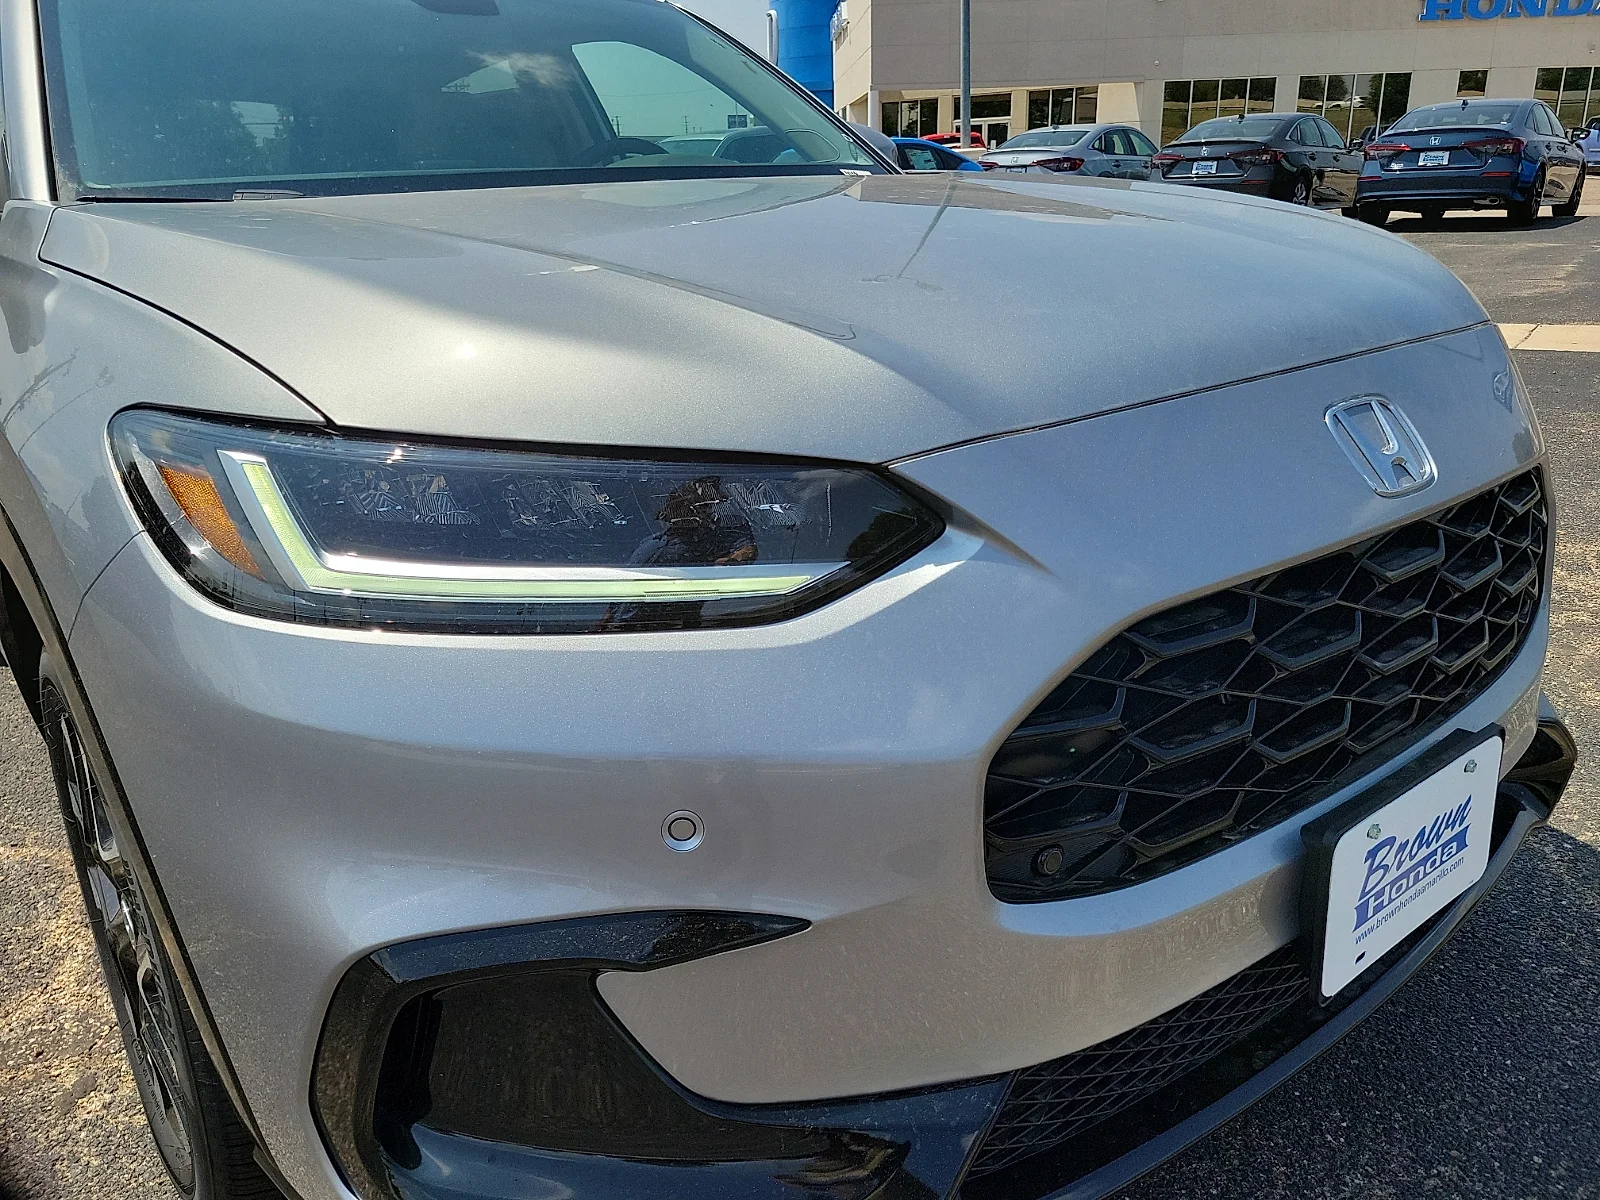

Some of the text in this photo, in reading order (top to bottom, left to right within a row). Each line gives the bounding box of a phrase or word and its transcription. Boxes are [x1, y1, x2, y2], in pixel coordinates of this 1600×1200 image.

[1419, 0, 1600, 21] HOND
[1358, 794, 1472, 903] Brown
[1366, 841, 1458, 919] Honda
[1355, 856, 1465, 945] www.brownhondaamarillo.com
